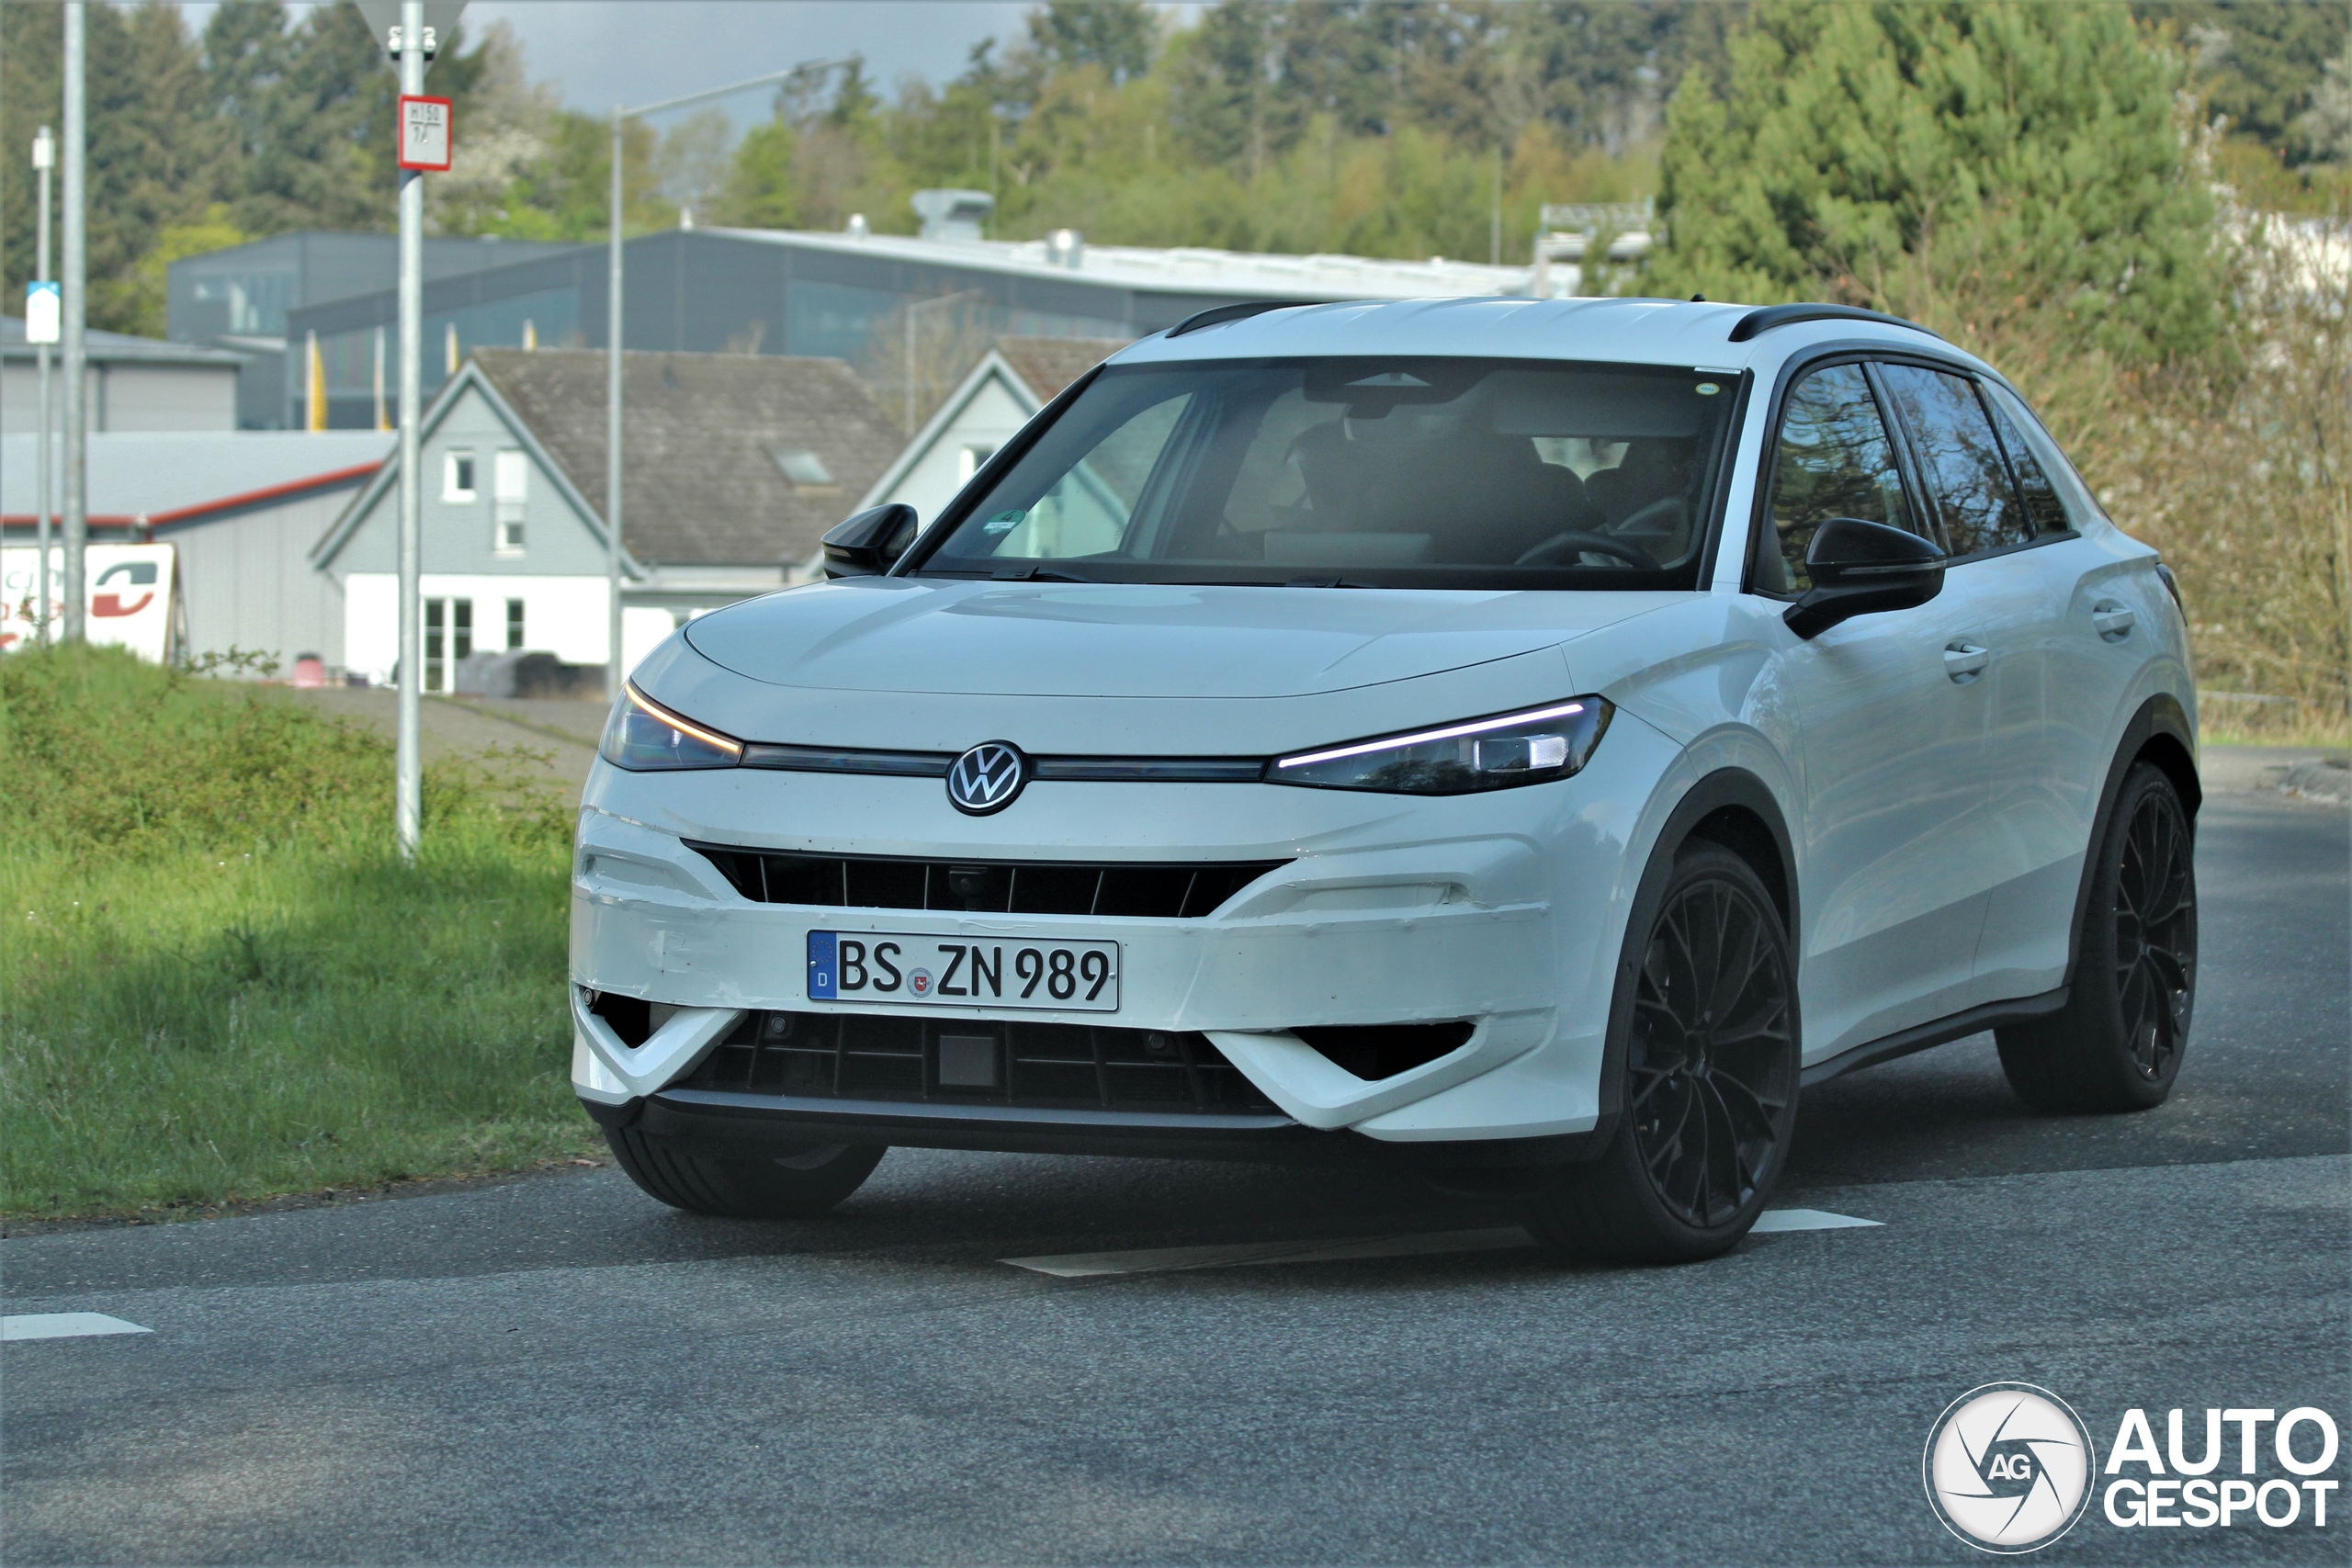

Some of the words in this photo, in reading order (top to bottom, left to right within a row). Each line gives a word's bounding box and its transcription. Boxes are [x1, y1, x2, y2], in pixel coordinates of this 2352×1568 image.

[956, 747, 1017, 801] VW
[818, 972, 828, 987] D
[839, 940, 902, 992] BS
[937, 943, 1002, 998] ZN
[1015, 947, 1110, 1001] 989
